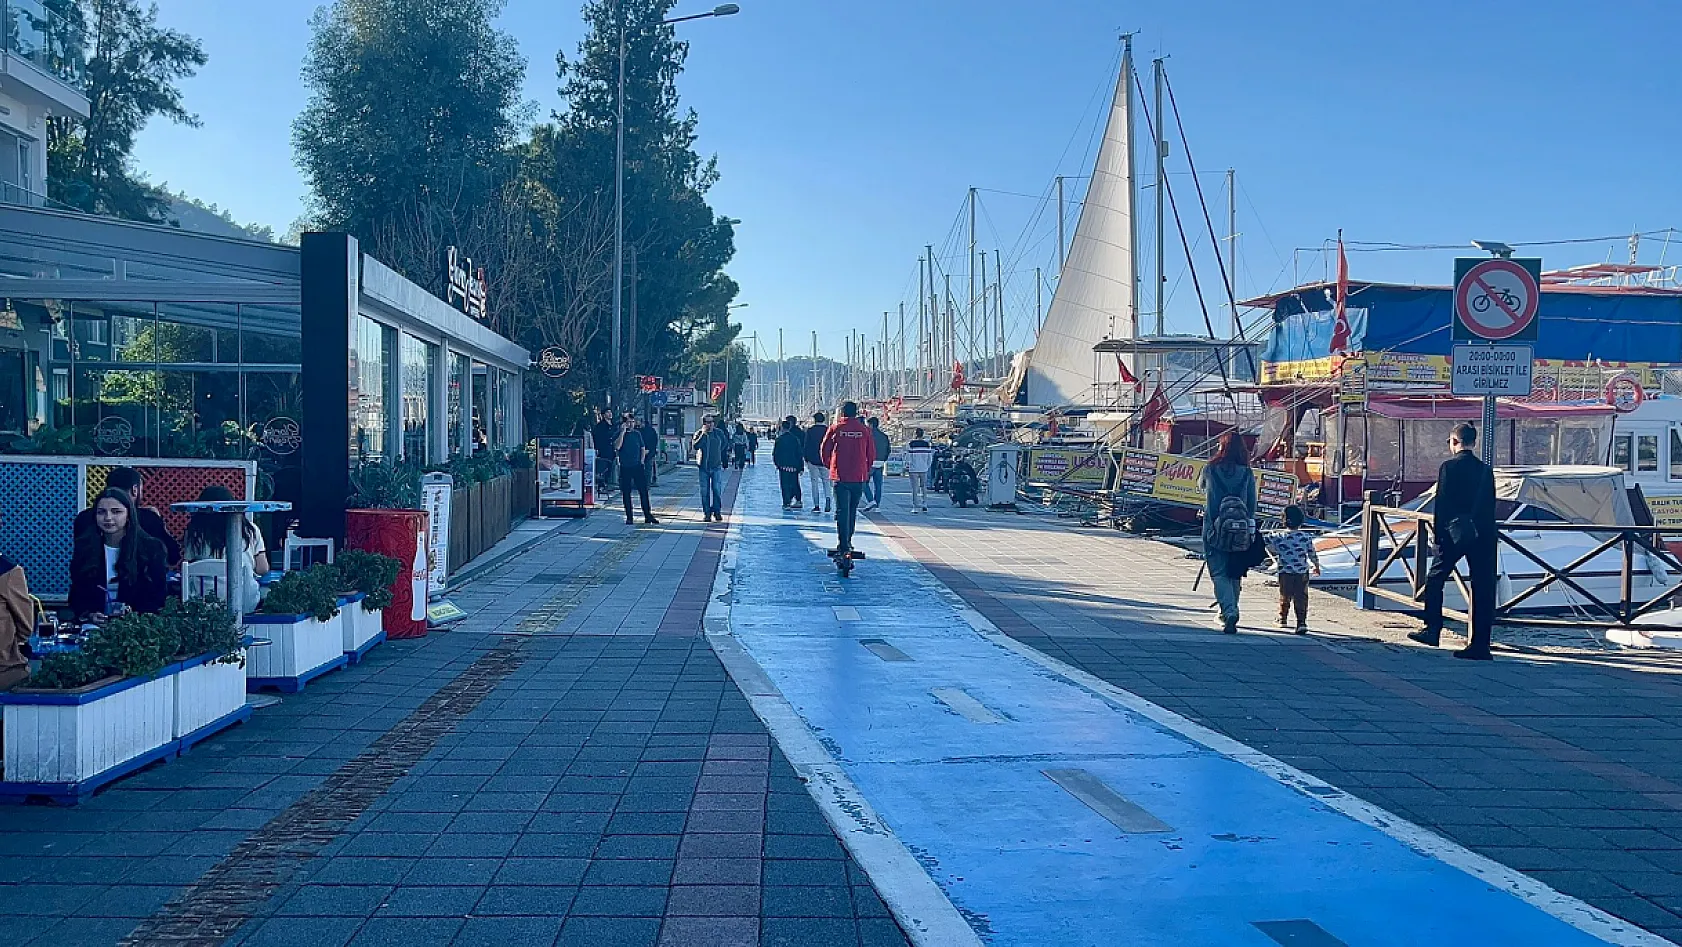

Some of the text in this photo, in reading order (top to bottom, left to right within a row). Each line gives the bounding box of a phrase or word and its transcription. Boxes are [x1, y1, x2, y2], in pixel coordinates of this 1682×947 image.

[1456, 365, 1480, 375] ARASI
[1515, 363, 1528, 375] İLE
[1473, 376, 1509, 389] GİRİLMEZ
[840, 431, 863, 439] hop
